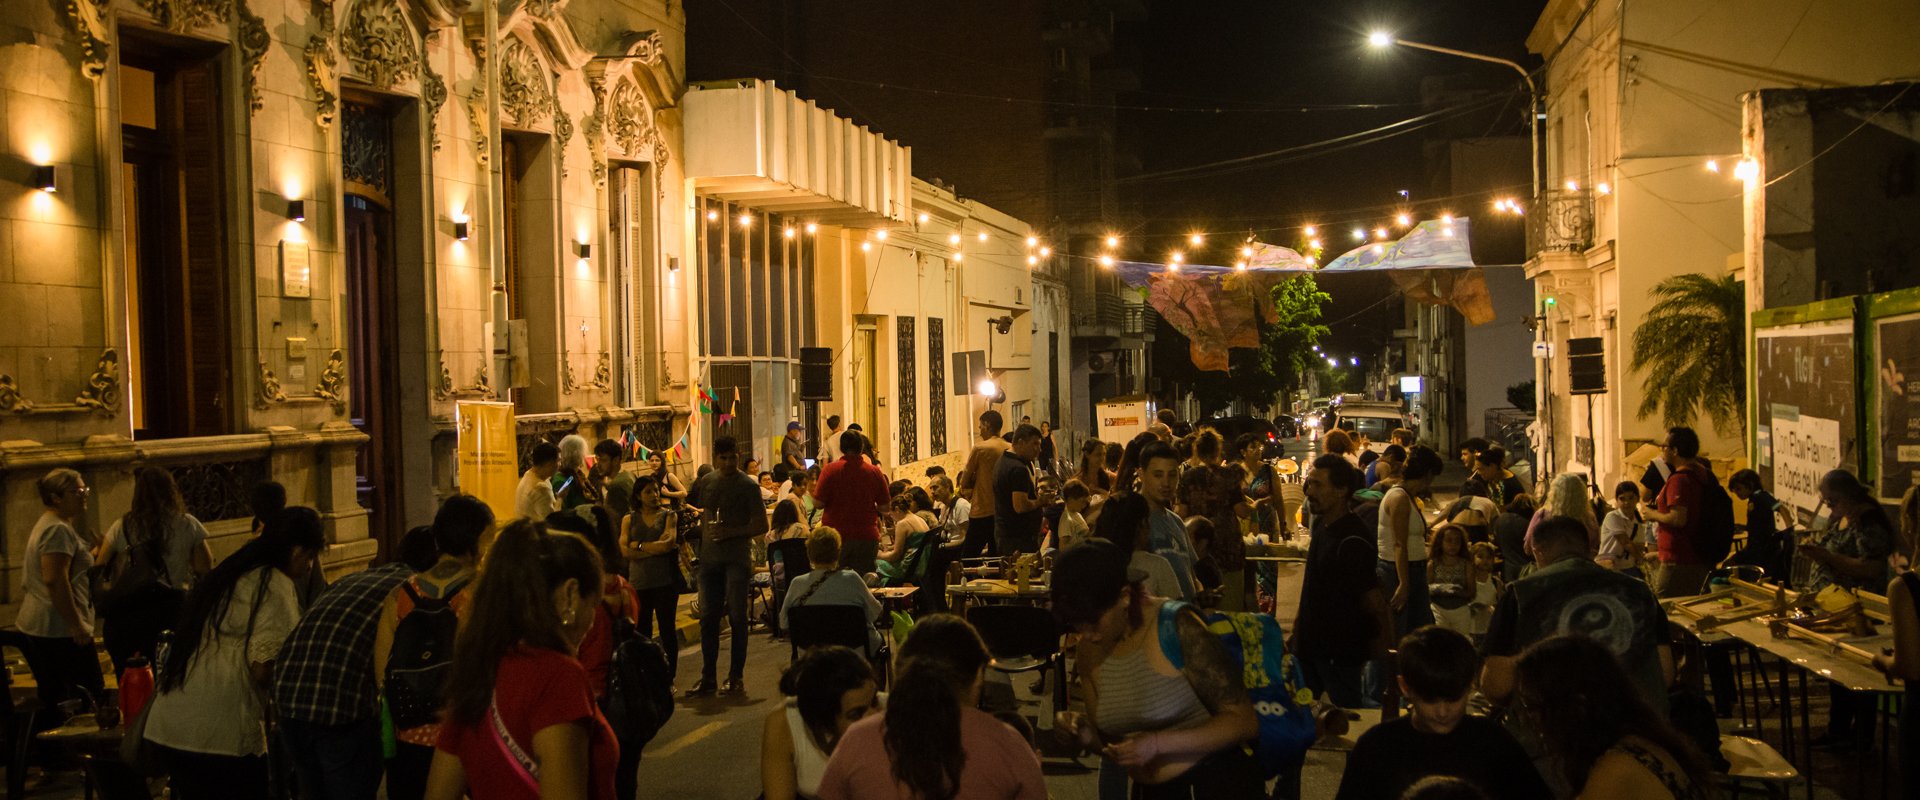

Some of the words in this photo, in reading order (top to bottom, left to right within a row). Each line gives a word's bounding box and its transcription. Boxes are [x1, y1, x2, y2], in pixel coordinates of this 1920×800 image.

[1795, 346, 1814, 384] flow
[1776, 427, 1788, 456] Con
[1789, 430, 1806, 460] Flow
[1806, 434, 1820, 464] Flex
[1783, 462, 1801, 496] Copa
[1802, 467, 1812, 496] del
